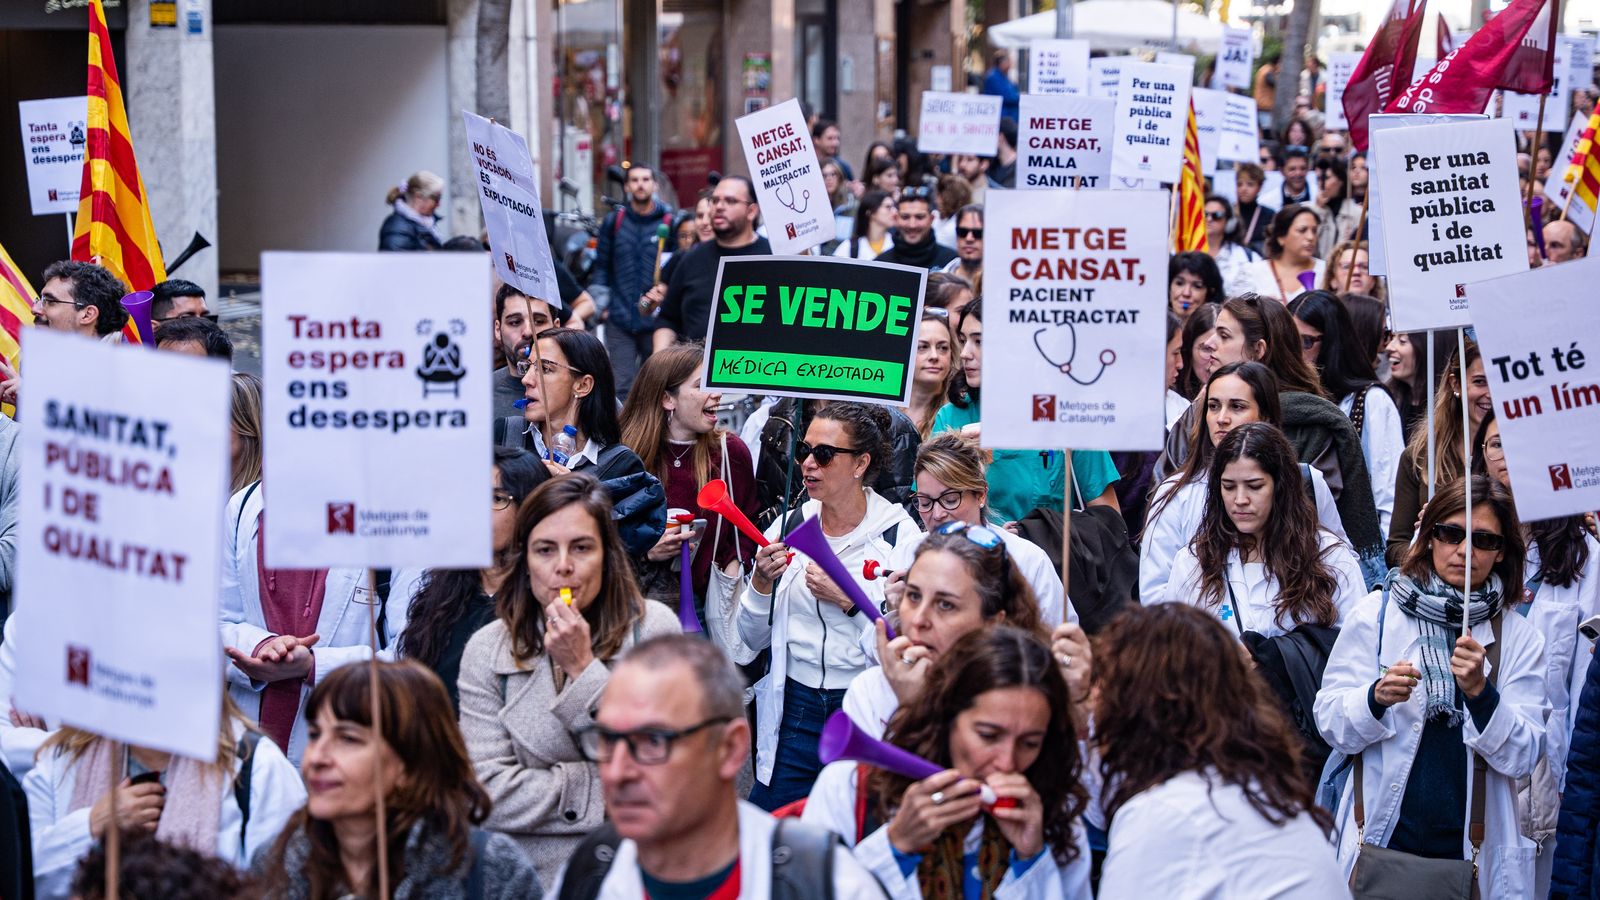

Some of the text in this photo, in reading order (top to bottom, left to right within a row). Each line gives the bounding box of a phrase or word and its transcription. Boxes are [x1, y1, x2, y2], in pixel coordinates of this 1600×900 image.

[1132, 78, 1175, 92] Per una
[1132, 93, 1172, 105] sanitat
[1129, 107, 1172, 119] pública
[29, 122, 58, 132] Tanta
[1029, 117, 1092, 131] METGE
[1138, 120, 1158, 131] i de
[31, 133, 65, 143] espera
[752, 124, 794, 149] METGE
[1029, 136, 1102, 153] CANSAT,
[1125, 133, 1170, 146] qualitat
[31, 145, 50, 153] ens
[473, 142, 497, 162] NO ÉS
[757, 138, 806, 165] CANSAT,
[476, 156, 516, 184] VOCACIÓ,
[760, 159, 791, 177] PACIENT
[1028, 155, 1077, 169] MALA
[1404, 150, 1491, 172] Per una
[480, 170, 491, 184] ÉS
[763, 165, 811, 189] MALTRACTAT
[1027, 174, 1099, 188] SANITAT
[1410, 172, 1490, 195] sanitat
[483, 186, 536, 218] EXPLOTACIÓ!
[1409, 198, 1496, 224] pública
[1011, 228, 1127, 250] METGE
[1431, 221, 1473, 241] i de
[1413, 243, 1503, 272] qualitat
[1010, 258, 1146, 286] CANSAT,
[1009, 288, 1095, 302] PACIENT
[720, 285, 912, 337] SE VENDE
[1009, 310, 1140, 324] MALTRACTAT
[287, 315, 382, 340] Tanta
[287, 349, 405, 373] espera
[1492, 342, 1586, 384] Tot té
[796, 362, 885, 382] EXPLOTADA
[287, 380, 348, 399] ens
[1059, 400, 1116, 411] Metges de
[1503, 395, 1543, 420] un
[287, 405, 468, 433] desespera
[1059, 413, 1116, 424] Catalunya
[44, 402, 177, 458] SANITAT,
[44, 442, 175, 495] PÚBLICA
[44, 482, 98, 520] I DE
[360, 511, 428, 523] Metges de
[360, 526, 429, 538] Catalunya
[43, 527, 188, 583] QUALITAT
